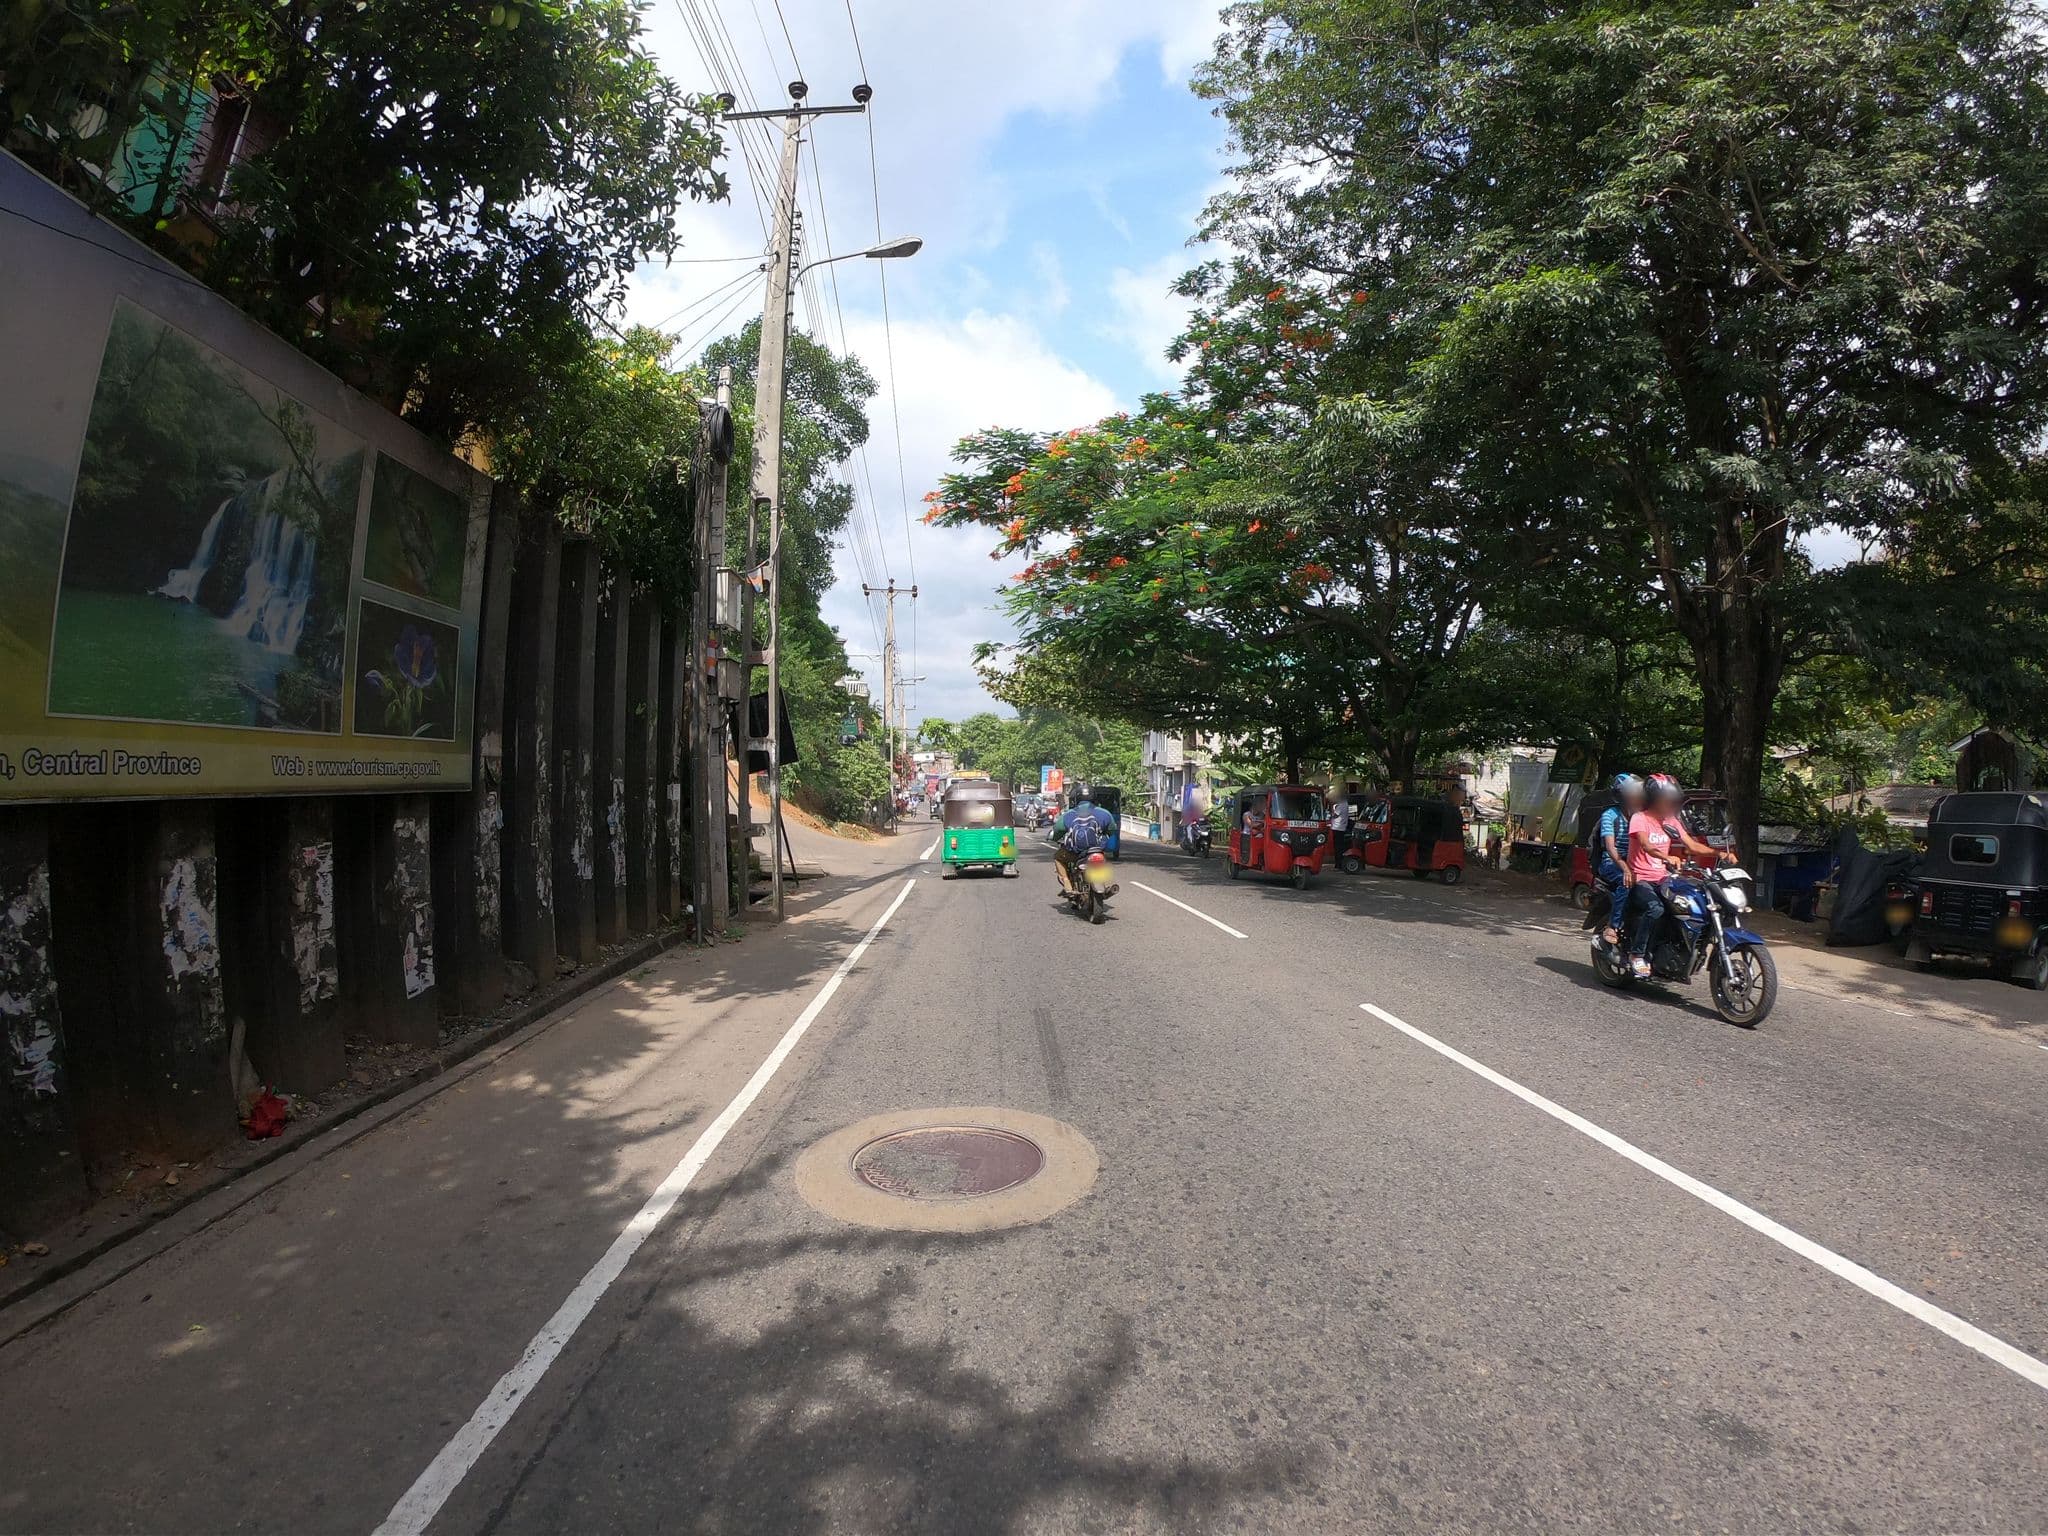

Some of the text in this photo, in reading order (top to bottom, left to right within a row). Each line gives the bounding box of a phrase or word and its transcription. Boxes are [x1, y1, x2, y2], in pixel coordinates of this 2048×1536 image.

[22, 748, 107, 776] Central
[113, 749, 201, 776] Province
[271, 754, 305, 776] Web
[315, 757, 441, 779] www.tourism.cp.gov.lk
